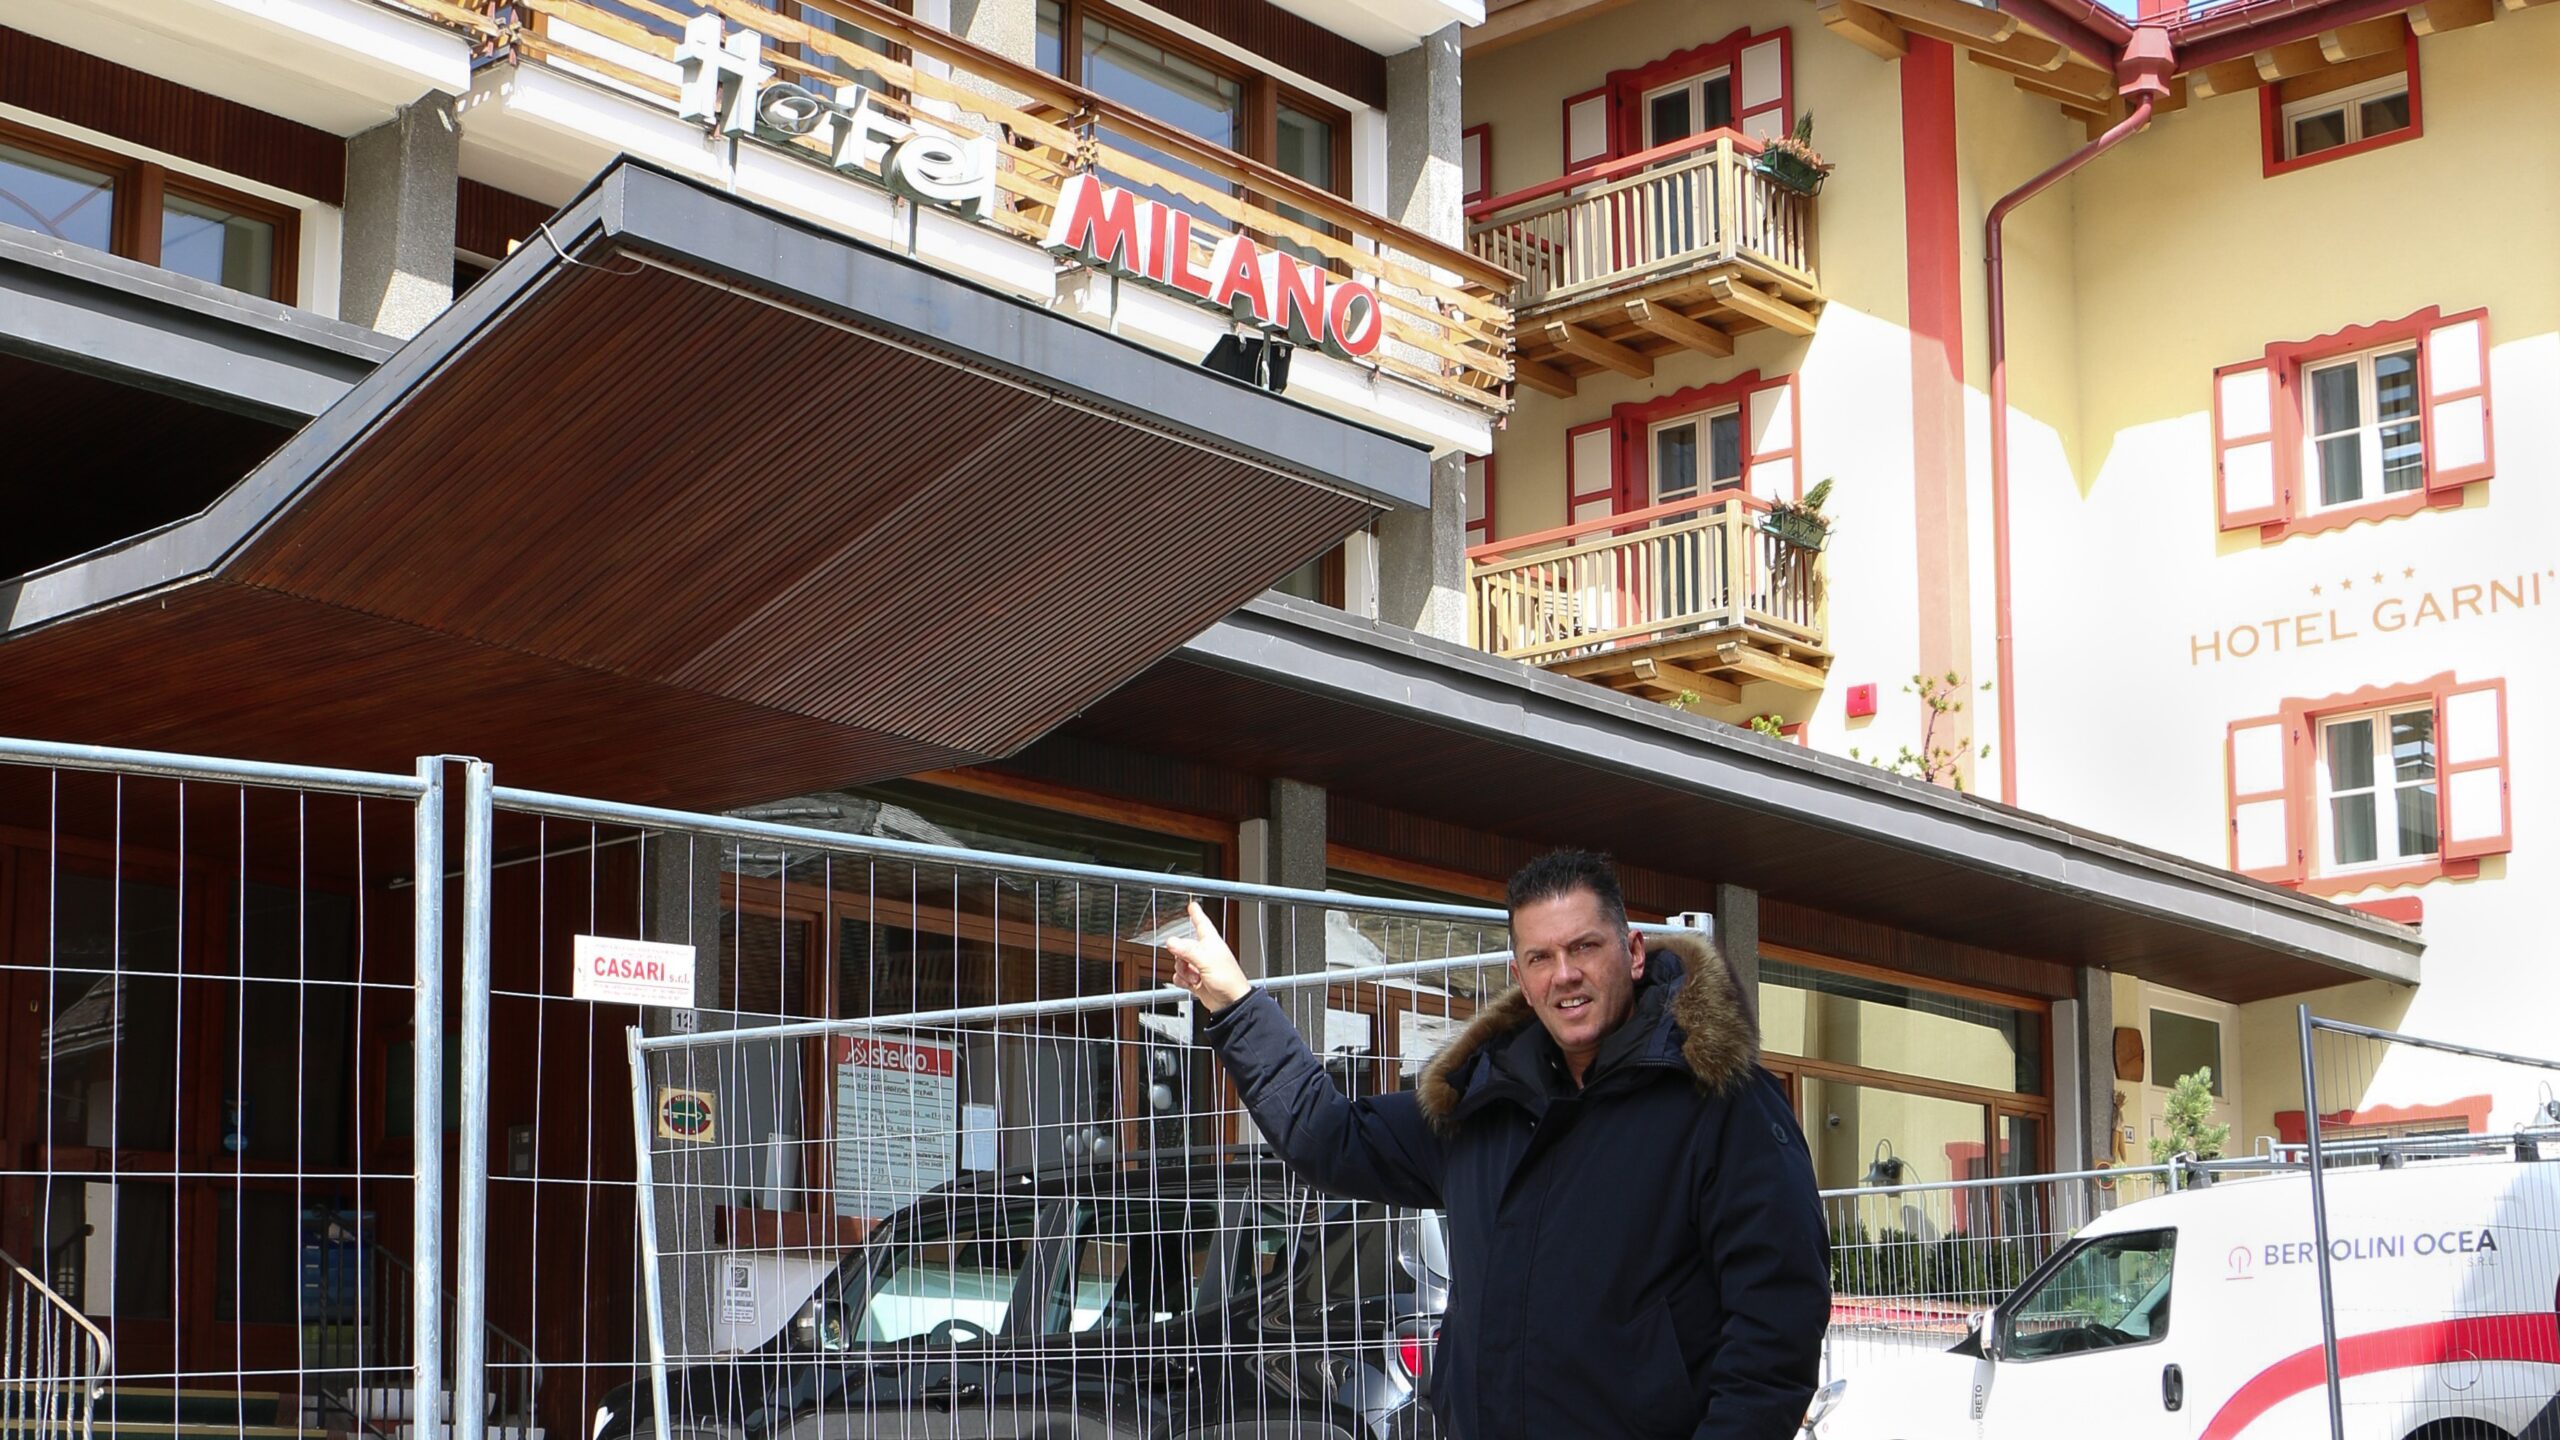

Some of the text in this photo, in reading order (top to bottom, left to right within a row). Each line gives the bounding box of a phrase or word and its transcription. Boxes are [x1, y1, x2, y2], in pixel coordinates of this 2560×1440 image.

[1048, 174, 1383, 356] MILANO
[2190, 608, 2358, 666] HOTEL
[594, 956, 665, 982] CASARI
[669, 974, 690, 985] s.r.l.
[676, 1012, 693, 1028] 12
[2264, 1229, 2498, 1266] BEROLINI OCEA
